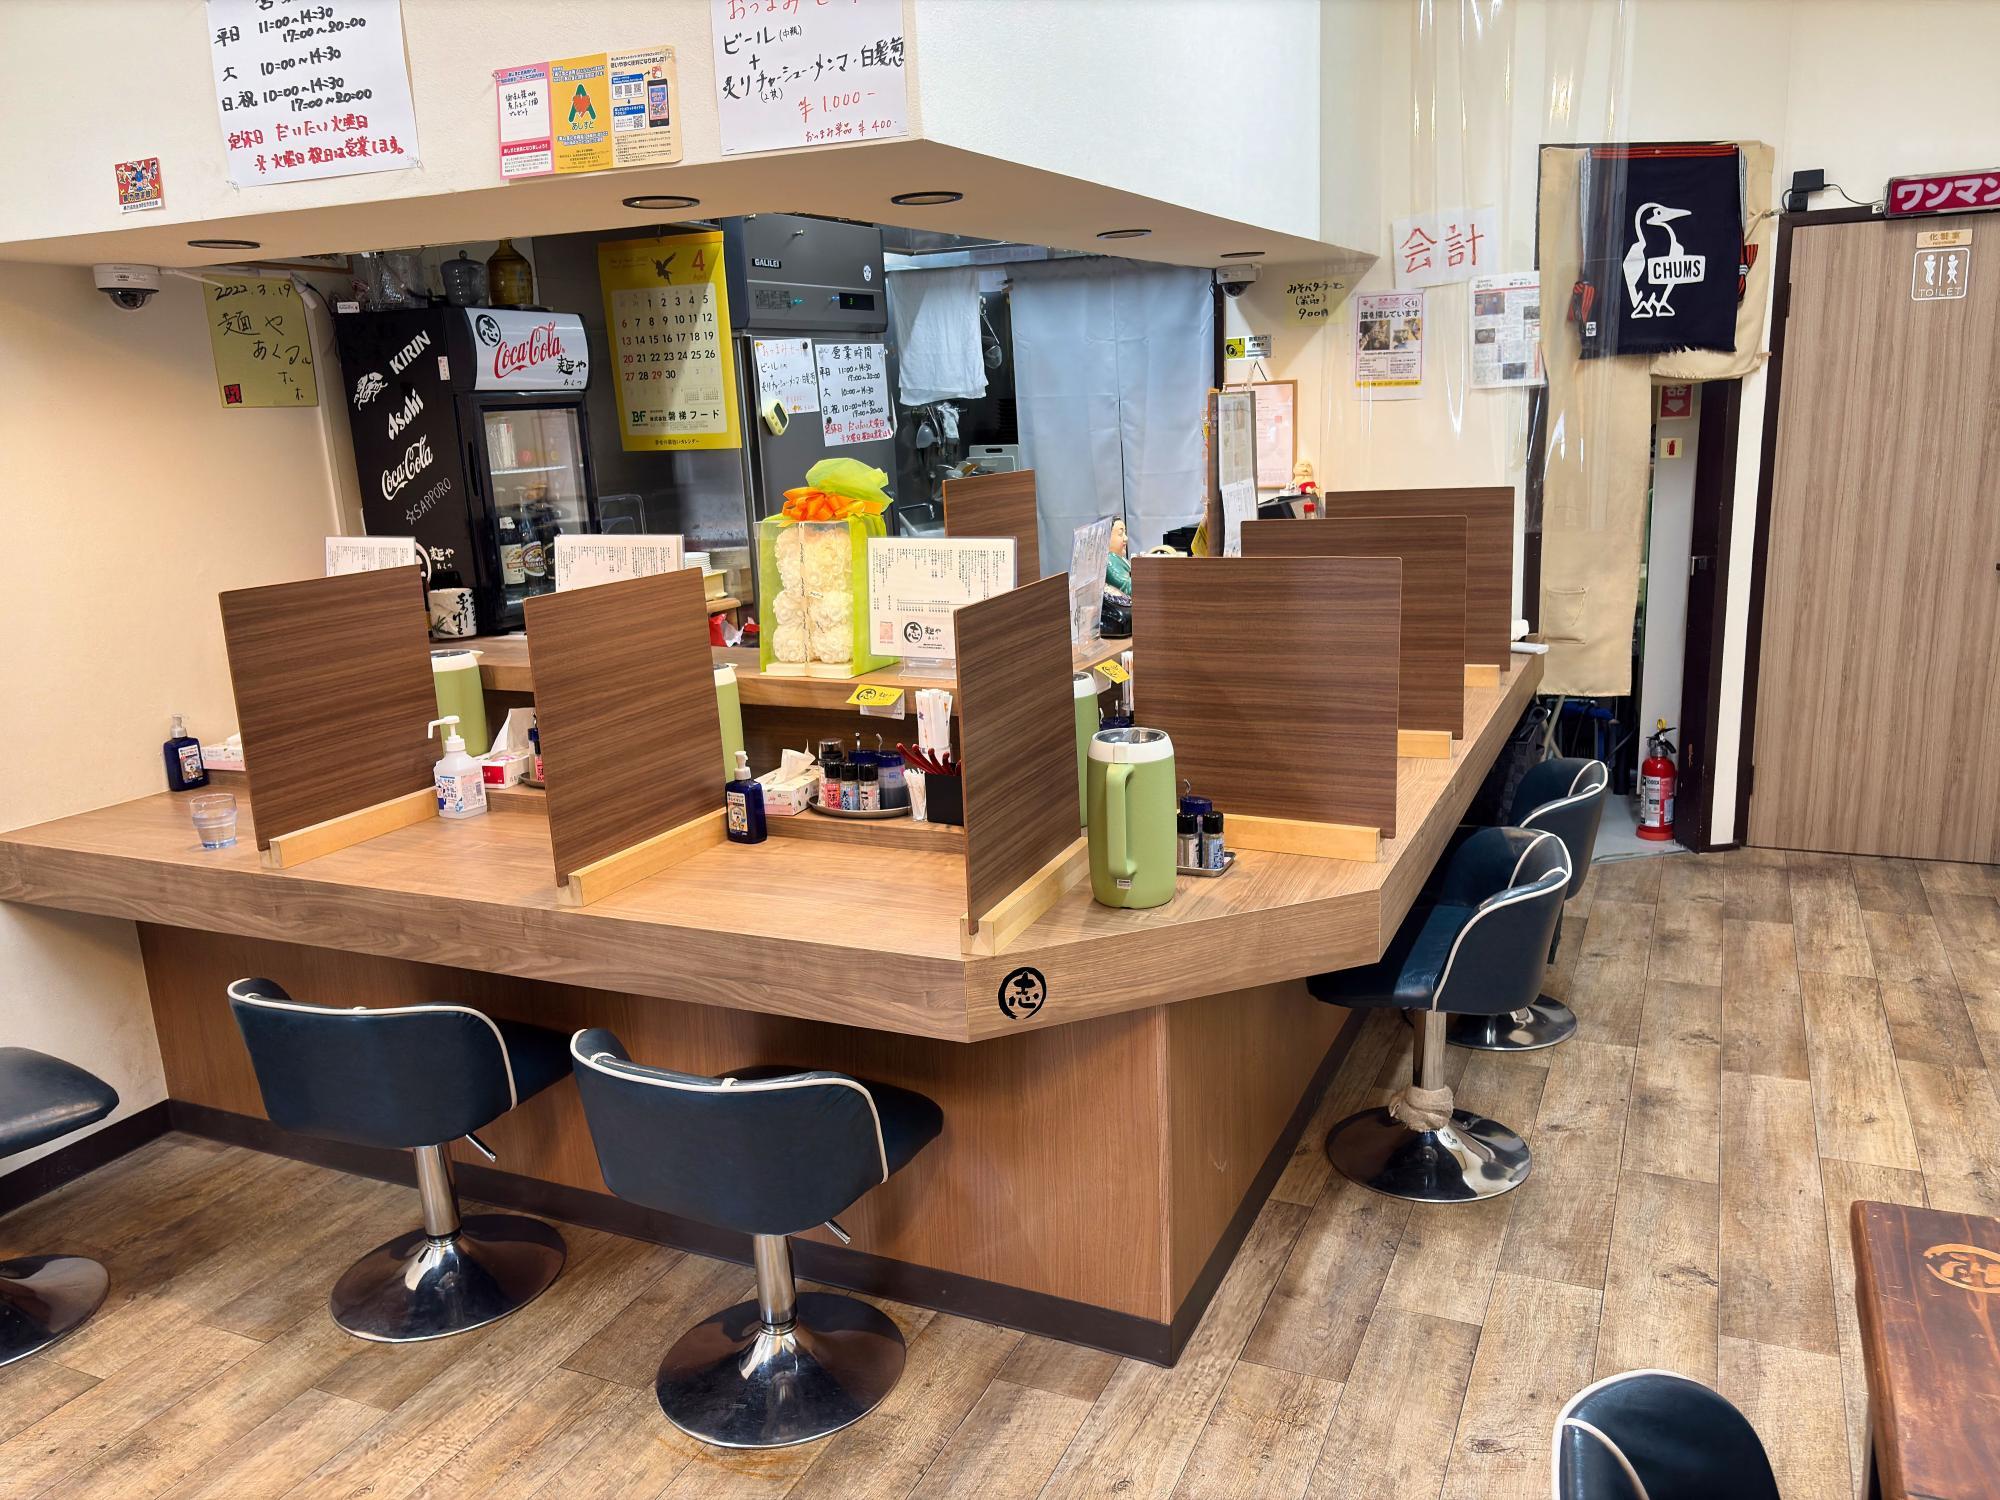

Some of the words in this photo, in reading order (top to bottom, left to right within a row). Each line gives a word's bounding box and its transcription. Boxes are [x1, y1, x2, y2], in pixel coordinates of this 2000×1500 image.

[214, 26, 240, 46] 平日
[724, 27, 775, 55] ビール
[228, 129, 264, 150] 定休日
[1401, 224, 1485, 274] 会計
[692, 248, 705, 271] 4
[754, 258, 780, 268] GALILEI
[1652, 259, 1701, 281] CHUMS
[647, 299, 652, 308] 1
[661, 298, 667, 307] 2
[675, 297, 681, 306] 3
[689, 295, 695, 305] 4
[702, 294, 709, 304] 5
[1919, 287, 1962, 298] TOILET
[621, 319, 627, 329] 6
[635, 318, 641, 327] 7
[649, 317, 655, 327] 8
[662, 316, 668, 325] 9
[674, 315, 685, 324] 10
[688, 314, 698, 323] 11
[702, 313, 713, 322] 12
[1360, 309, 1420, 320] 猫を探しています
[621, 336, 632, 346] 13
[635, 336, 646, 345] 14
[649, 335, 659, 344] 15
[662, 334, 673, 343] 16
[676, 333, 686, 342] 17
[690, 332, 700, 341] 18
[704, 331, 714, 341] 19
[389, 330, 431, 375] KIRIN
[494, 320, 561, 379] Coca-Cola
[623, 354, 634, 364] 20
[637, 354, 646, 363] 21
[650, 352, 661, 362] 22
[663, 352, 675, 361] 23
[677, 351, 688, 360] 24
[691, 350, 702, 360] 25
[704, 349, 716, 359] 26
[832, 346, 872, 360] 営業時間
[555, 355, 587, 375] 麺や
[820, 367, 830, 380] 平日
[625, 372, 635, 382] 27
[638, 371, 649, 380] 28
[651, 370, 662, 380] 29
[665, 369, 676, 378] 30
[388, 387, 424, 440] Asahi
[631, 410, 647, 422] BF
[381, 434, 433, 500] Coca-Cola
[413, 477, 452, 519] SAPPORO
[429, 545, 455, 561] 麺や
[1005, 969, 1041, 1012] 志
